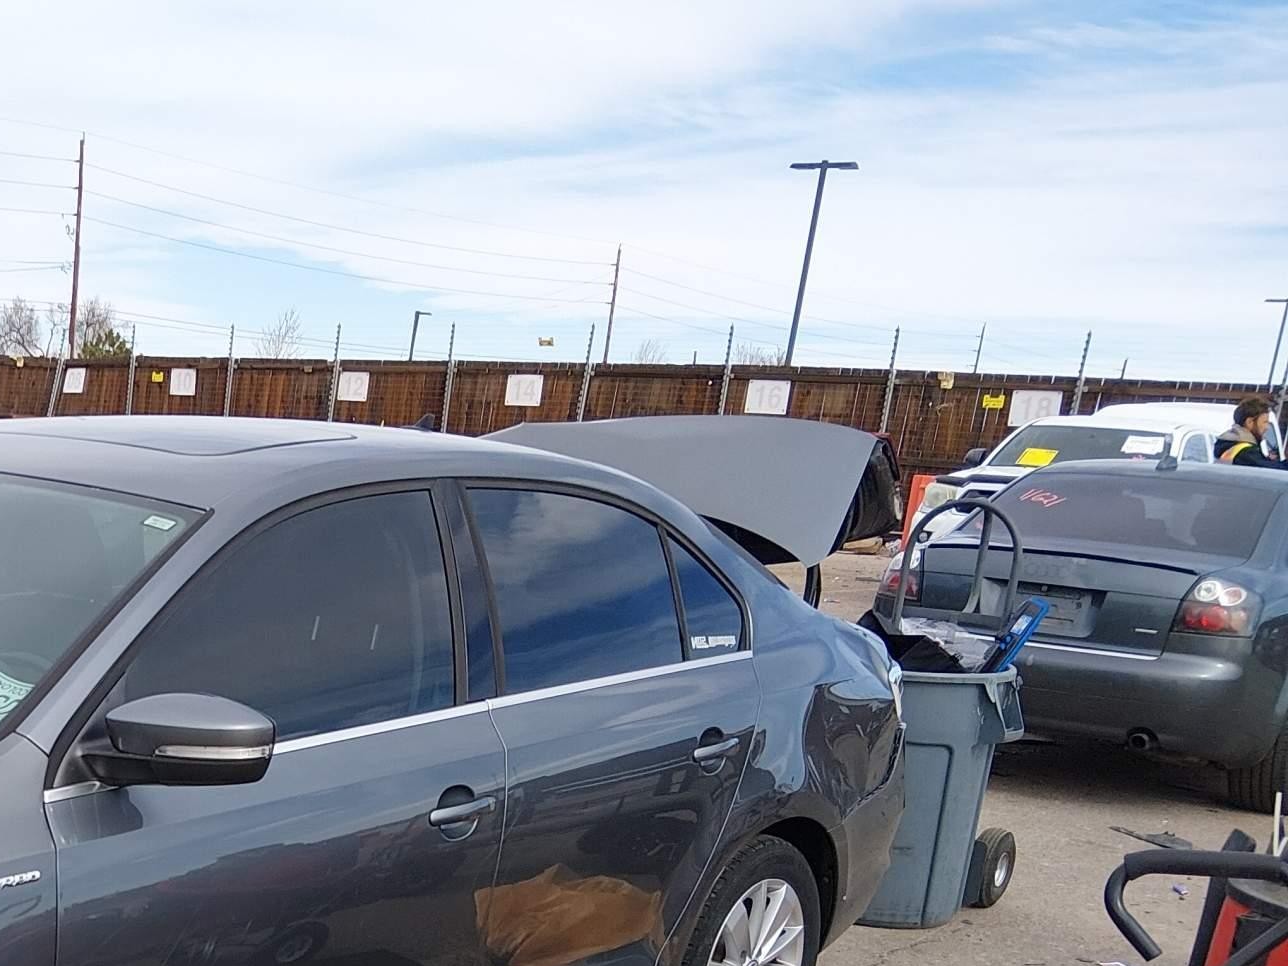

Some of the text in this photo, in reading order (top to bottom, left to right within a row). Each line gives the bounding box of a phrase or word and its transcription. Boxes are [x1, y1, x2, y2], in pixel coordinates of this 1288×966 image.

[344, 375, 364, 397] 12
[514, 379, 536, 401] 14
[755, 384, 783, 409] 16
[1022, 396, 1052, 420] 18
